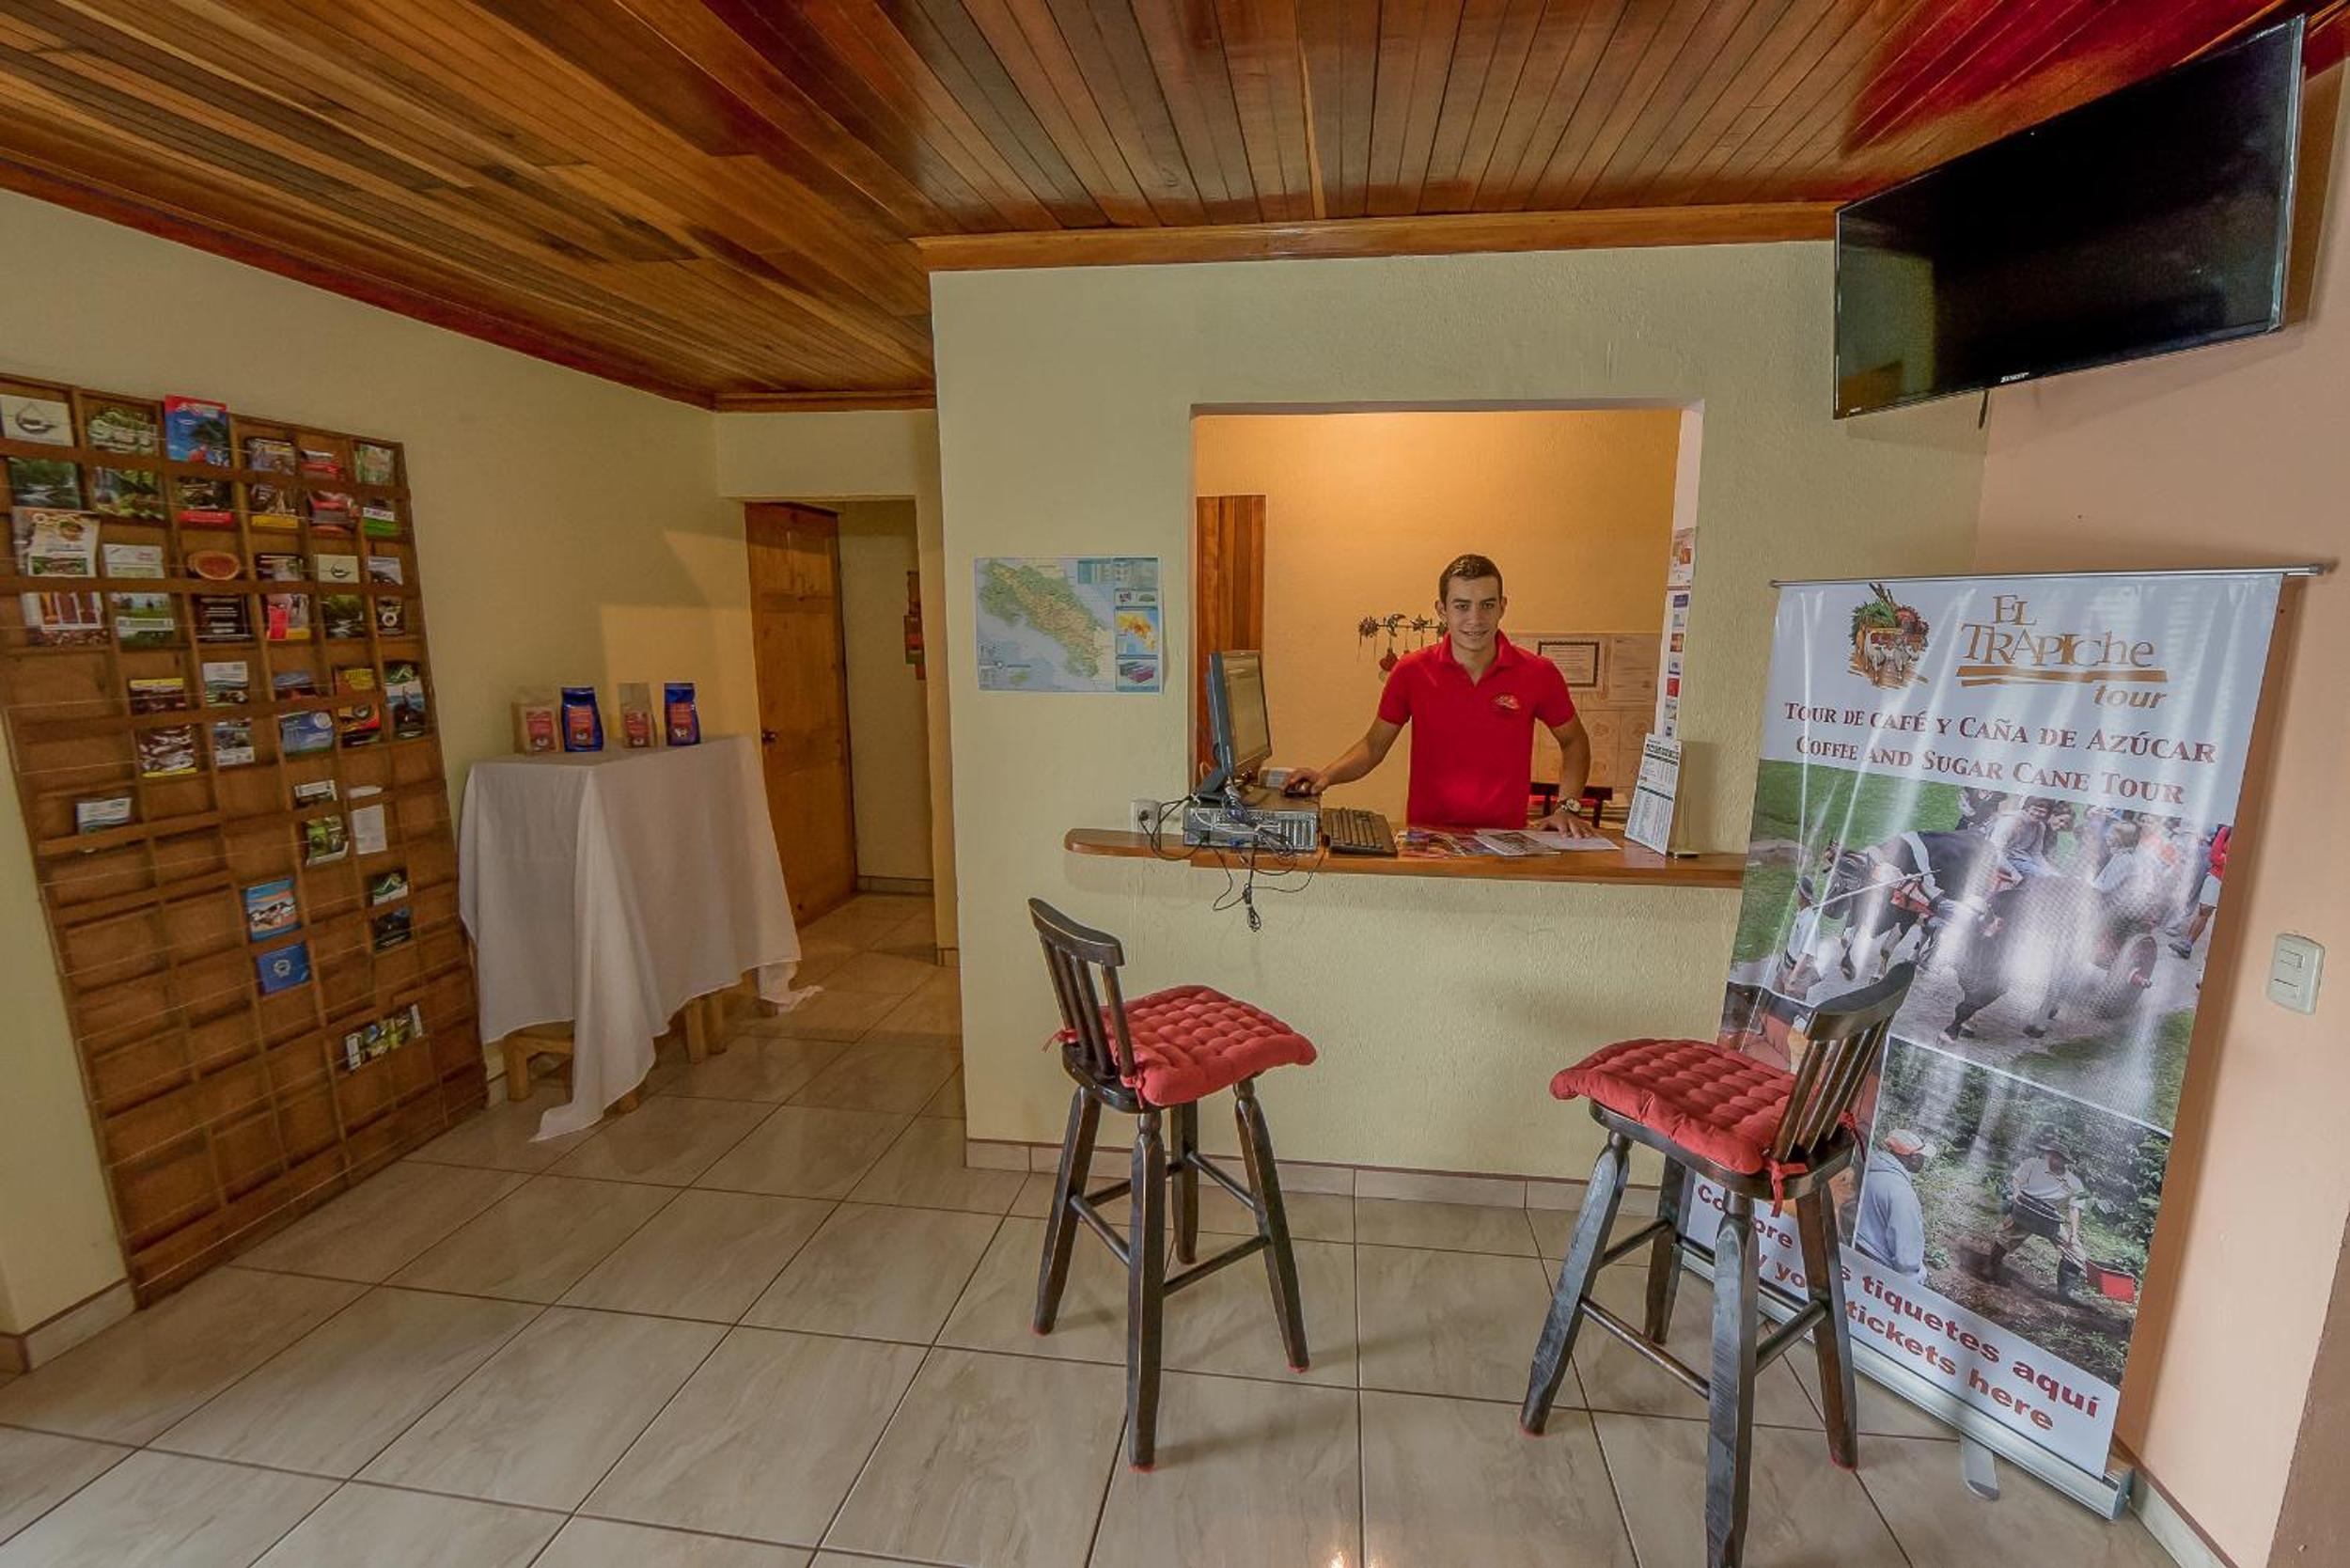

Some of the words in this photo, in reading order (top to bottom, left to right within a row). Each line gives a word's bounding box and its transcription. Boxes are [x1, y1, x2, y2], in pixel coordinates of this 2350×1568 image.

[1992, 594, 2037, 626] EL
[2093, 684, 2167, 709] tour
[1843, 710, 1865, 726] DE
[1935, 717, 1952, 735] Y
[1959, 716, 2029, 745] CAÑA
[2038, 728, 2077, 748] DE
[2086, 728, 2217, 763] AZÚCAR
[1868, 746, 1914, 767] AND
[1922, 749, 2003, 780] SUGAR
[2013, 761, 2091, 792] CANE
[2101, 771, 2184, 805] TOUR
[1845, 1300, 1956, 1376] tickets
[1967, 1368, 2054, 1431] here
[1862, 1275, 2000, 1363] tiquetes
[2013, 1359, 2101, 1418] aquí
